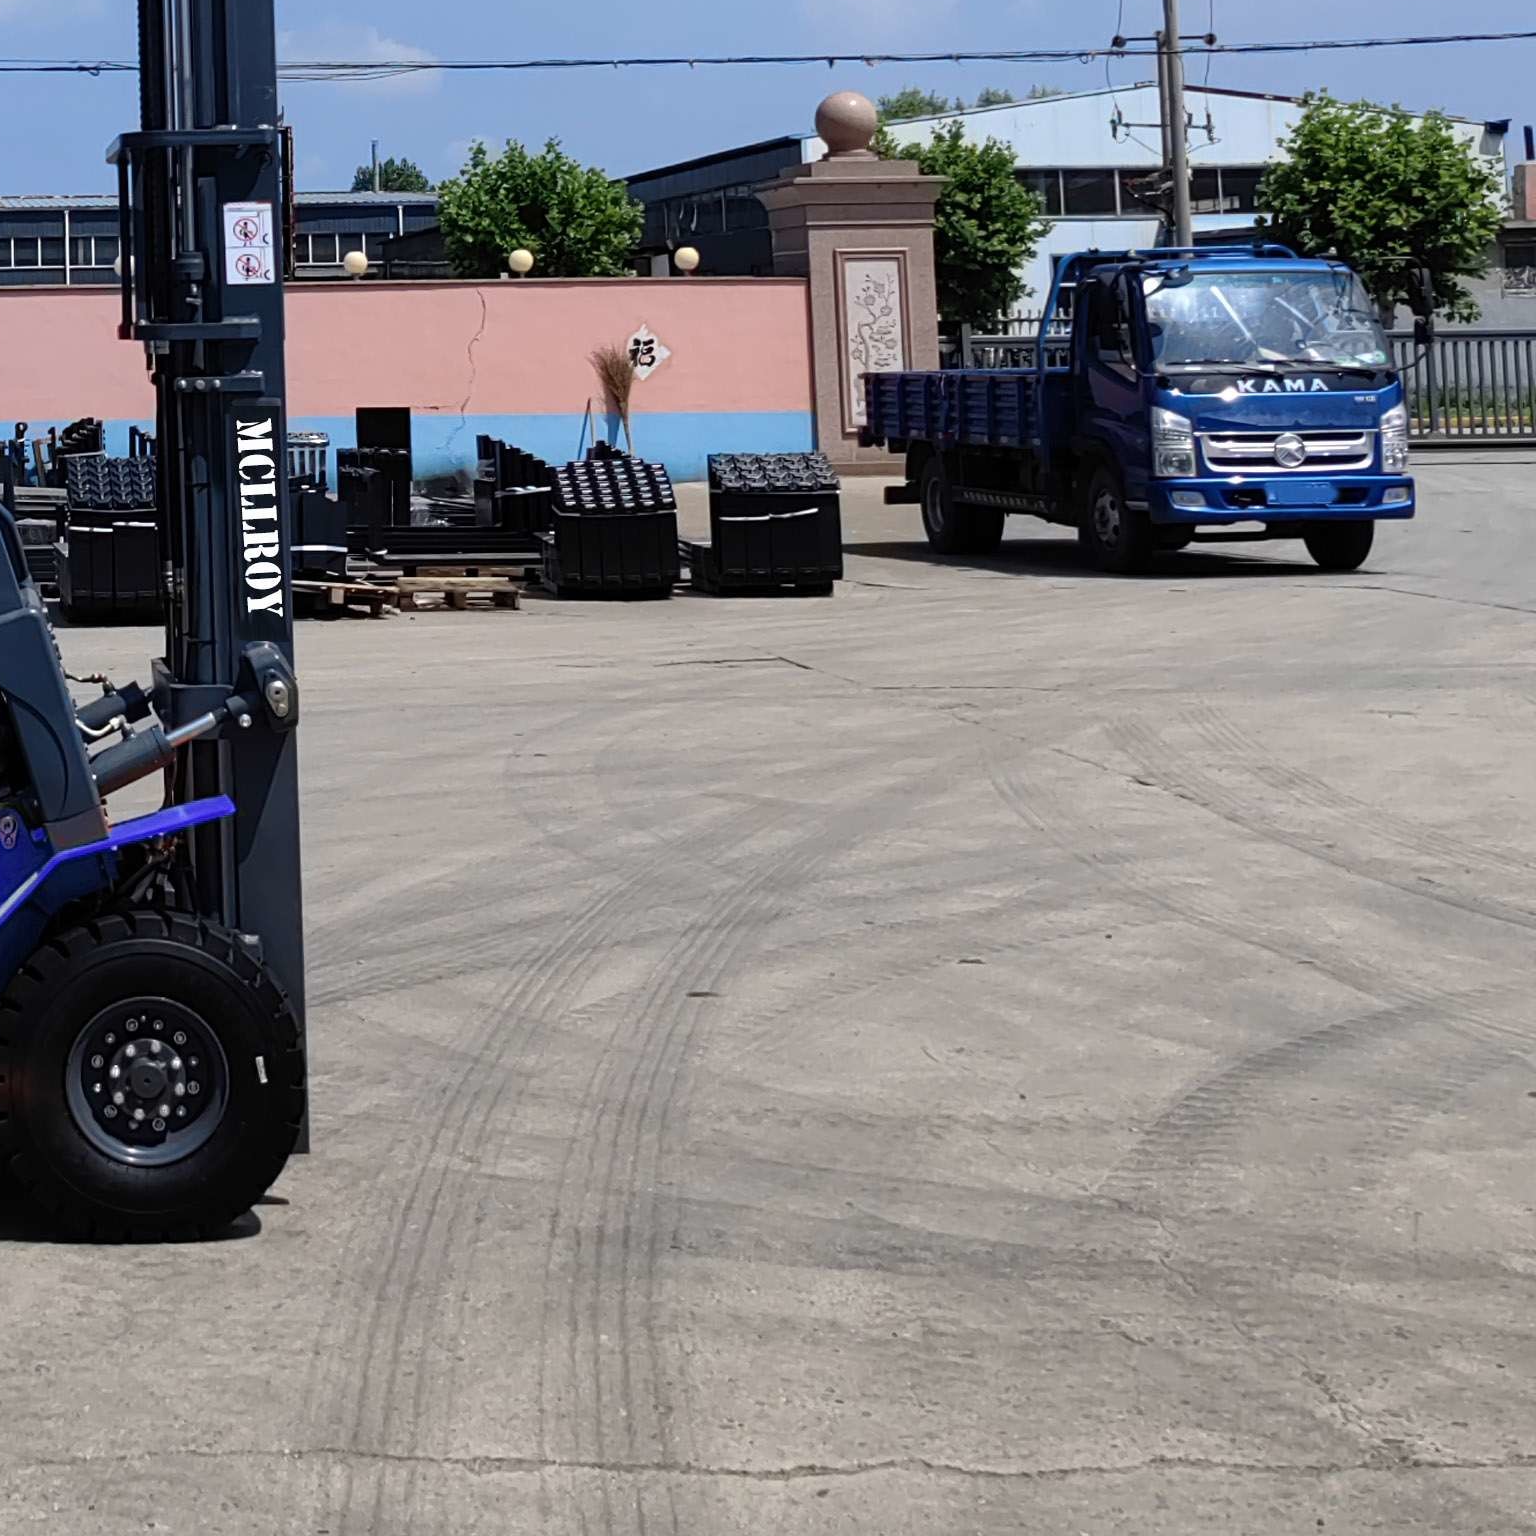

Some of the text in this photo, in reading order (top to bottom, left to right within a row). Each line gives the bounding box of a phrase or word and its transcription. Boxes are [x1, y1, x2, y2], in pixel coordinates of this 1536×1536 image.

[629, 338, 656, 367] 福
[1236, 378, 1329, 393] KAMA
[236, 417, 284, 617] MCLLROY
